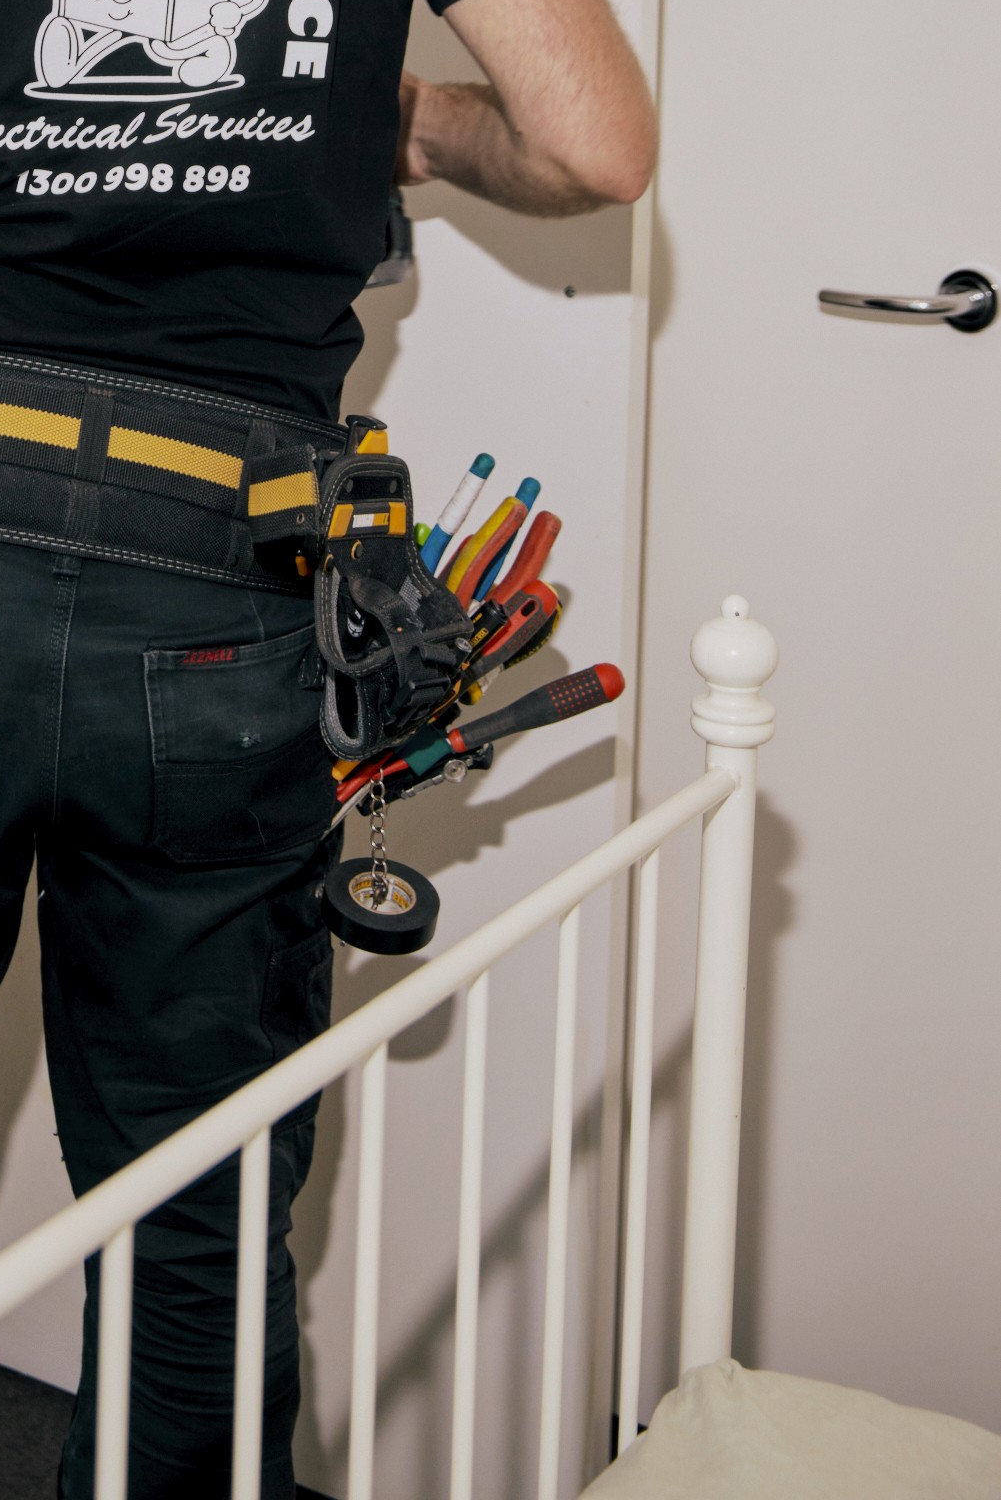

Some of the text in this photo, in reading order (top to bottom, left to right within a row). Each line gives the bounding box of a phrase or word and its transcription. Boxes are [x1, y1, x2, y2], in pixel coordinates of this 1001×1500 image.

[142, 103, 316, 145] Services
[15, 162, 251, 196] 1300 998 898
